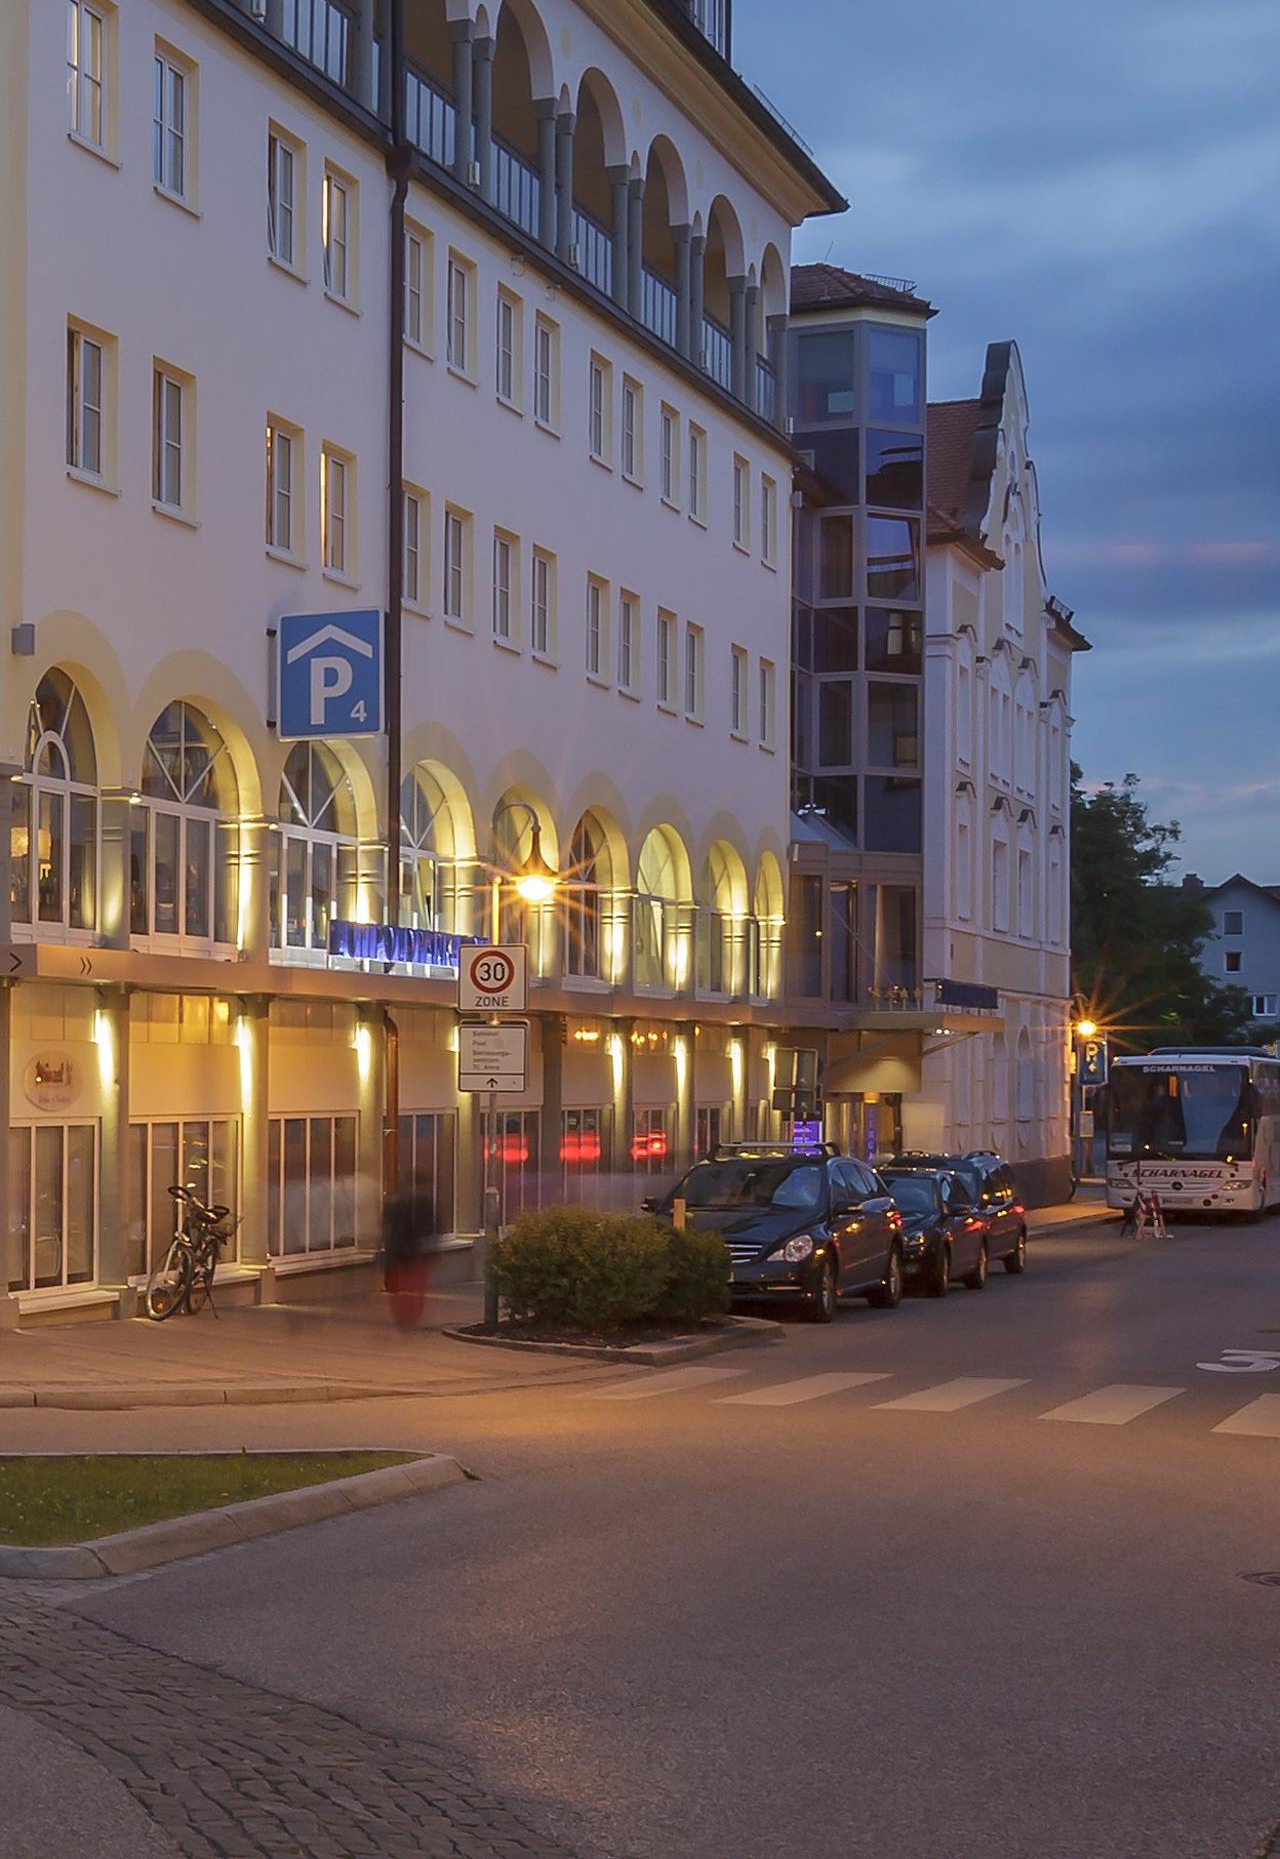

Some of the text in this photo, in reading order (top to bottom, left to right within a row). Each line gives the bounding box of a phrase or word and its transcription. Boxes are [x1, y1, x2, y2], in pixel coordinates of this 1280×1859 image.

[310, 656, 367, 725] P 4
[479, 962, 505, 982] 30
[475, 996, 509, 1007] ZONE
[1142, 1065, 1216, 1073] SCHARNAGEL
